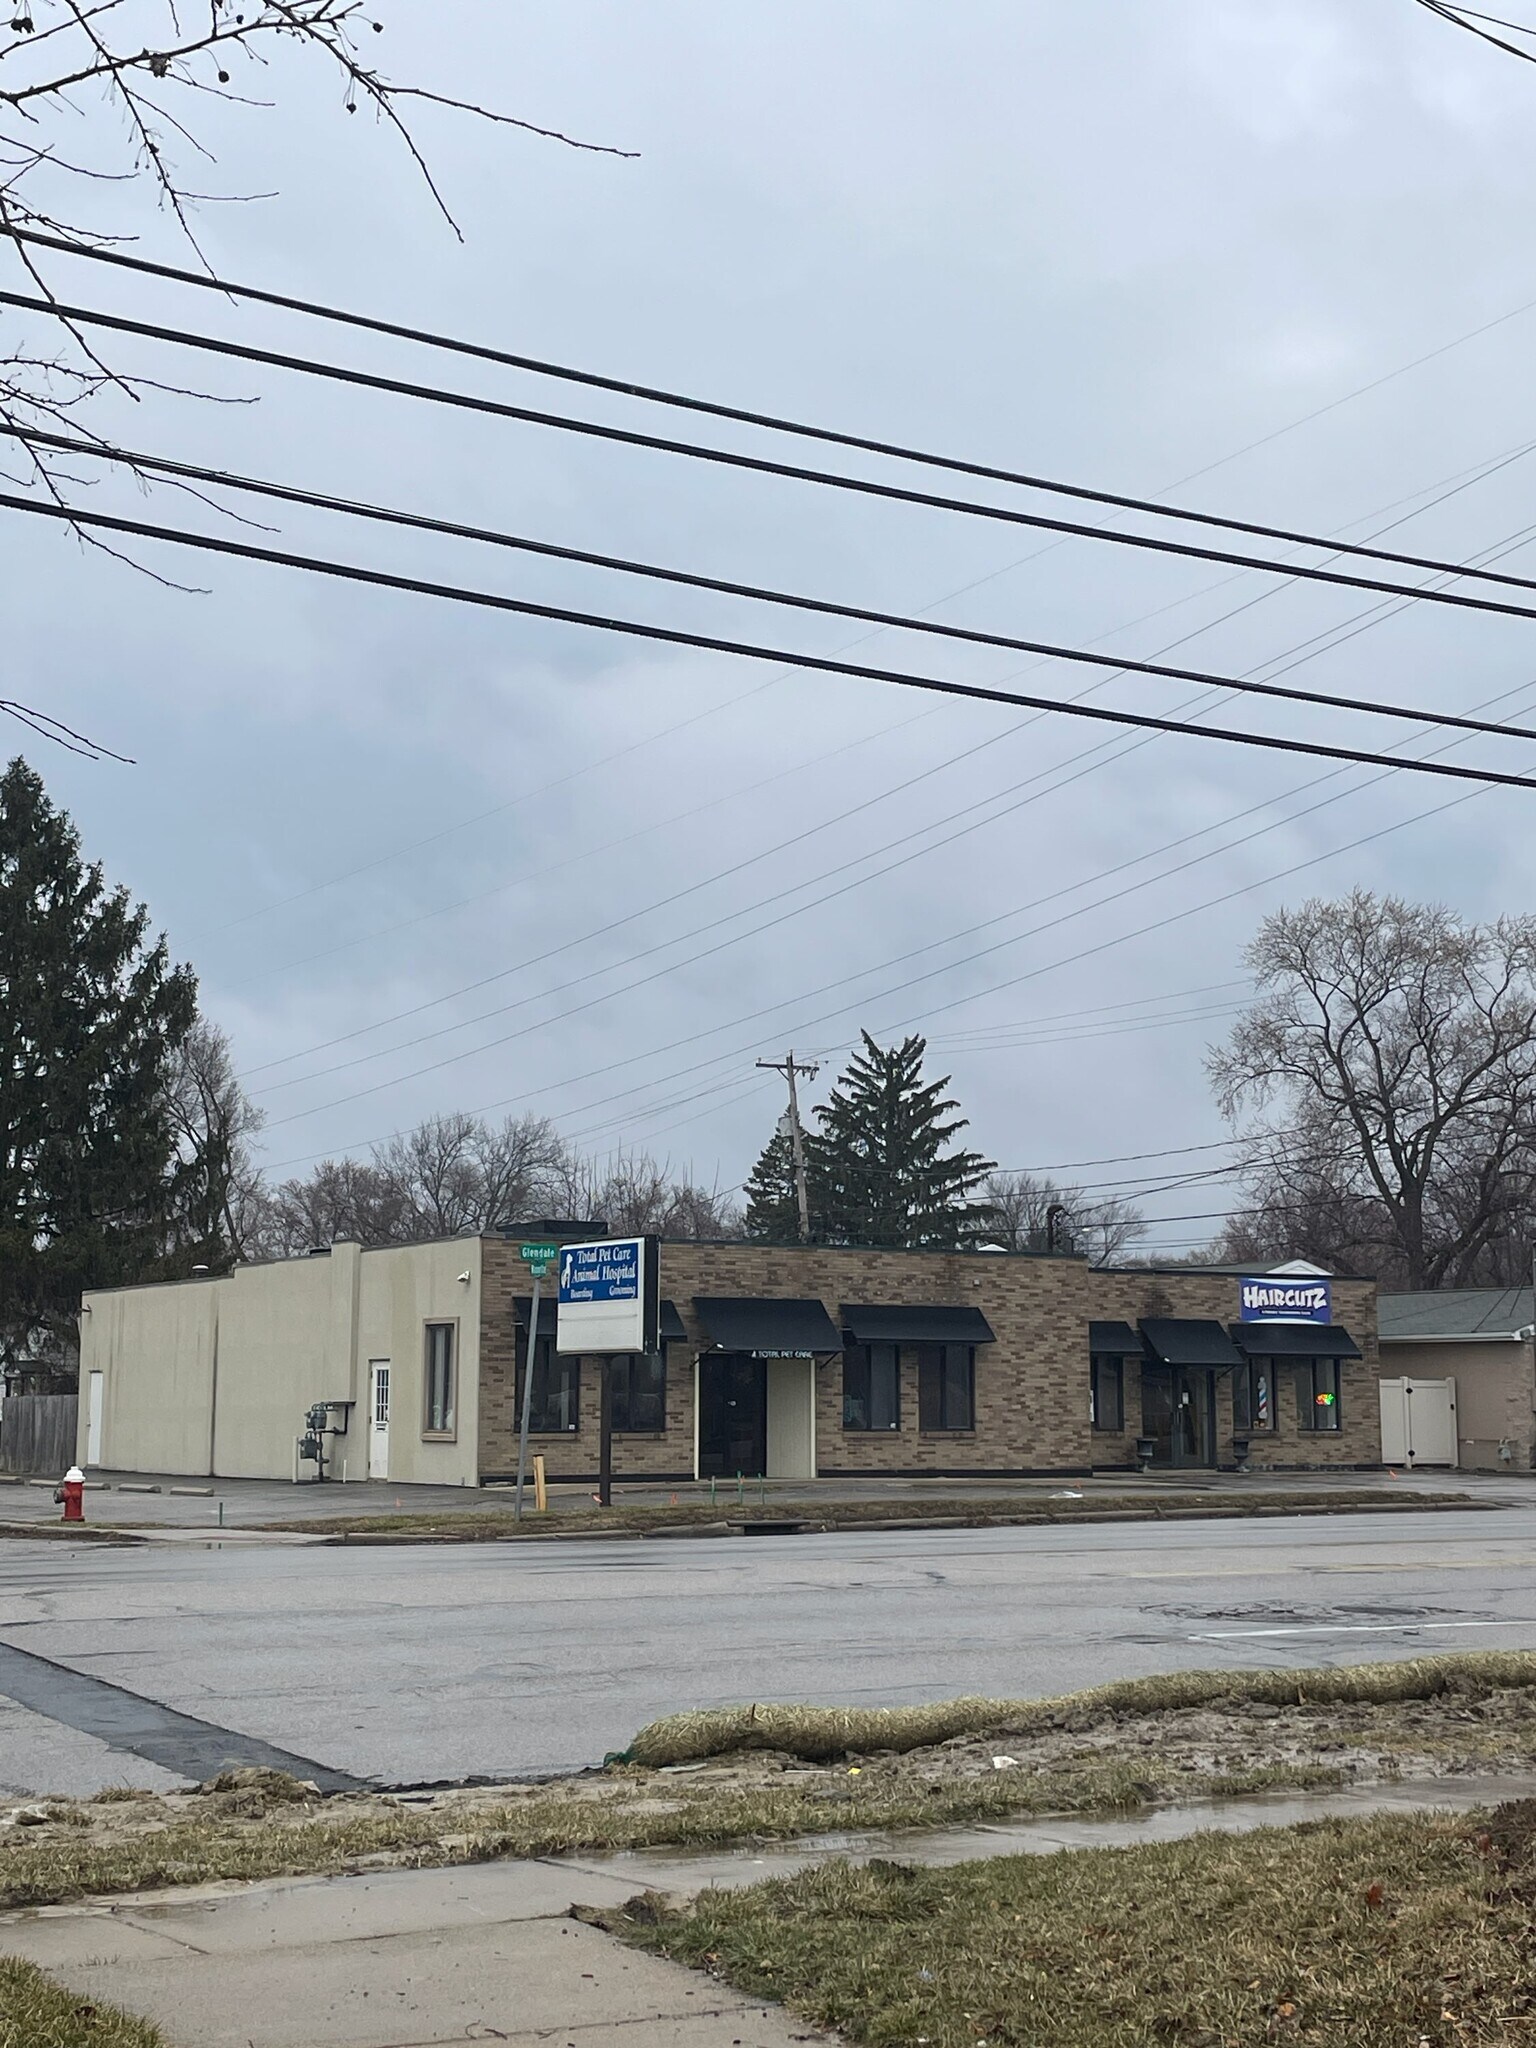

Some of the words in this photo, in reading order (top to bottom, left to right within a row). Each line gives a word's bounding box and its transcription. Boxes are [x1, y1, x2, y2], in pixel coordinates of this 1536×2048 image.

[522, 1247, 555, 1258] Glendale
[577, 1247, 598, 1264] Total
[598, 1248, 611, 1262] Pet
[613, 1247, 631, 1261] Care
[571, 1264, 600, 1283] Animal
[602, 1261, 636, 1285] Hospital
[1243, 1285, 1327, 1310] HAIRCUTZ
[781, 1350, 793, 1358] PET
